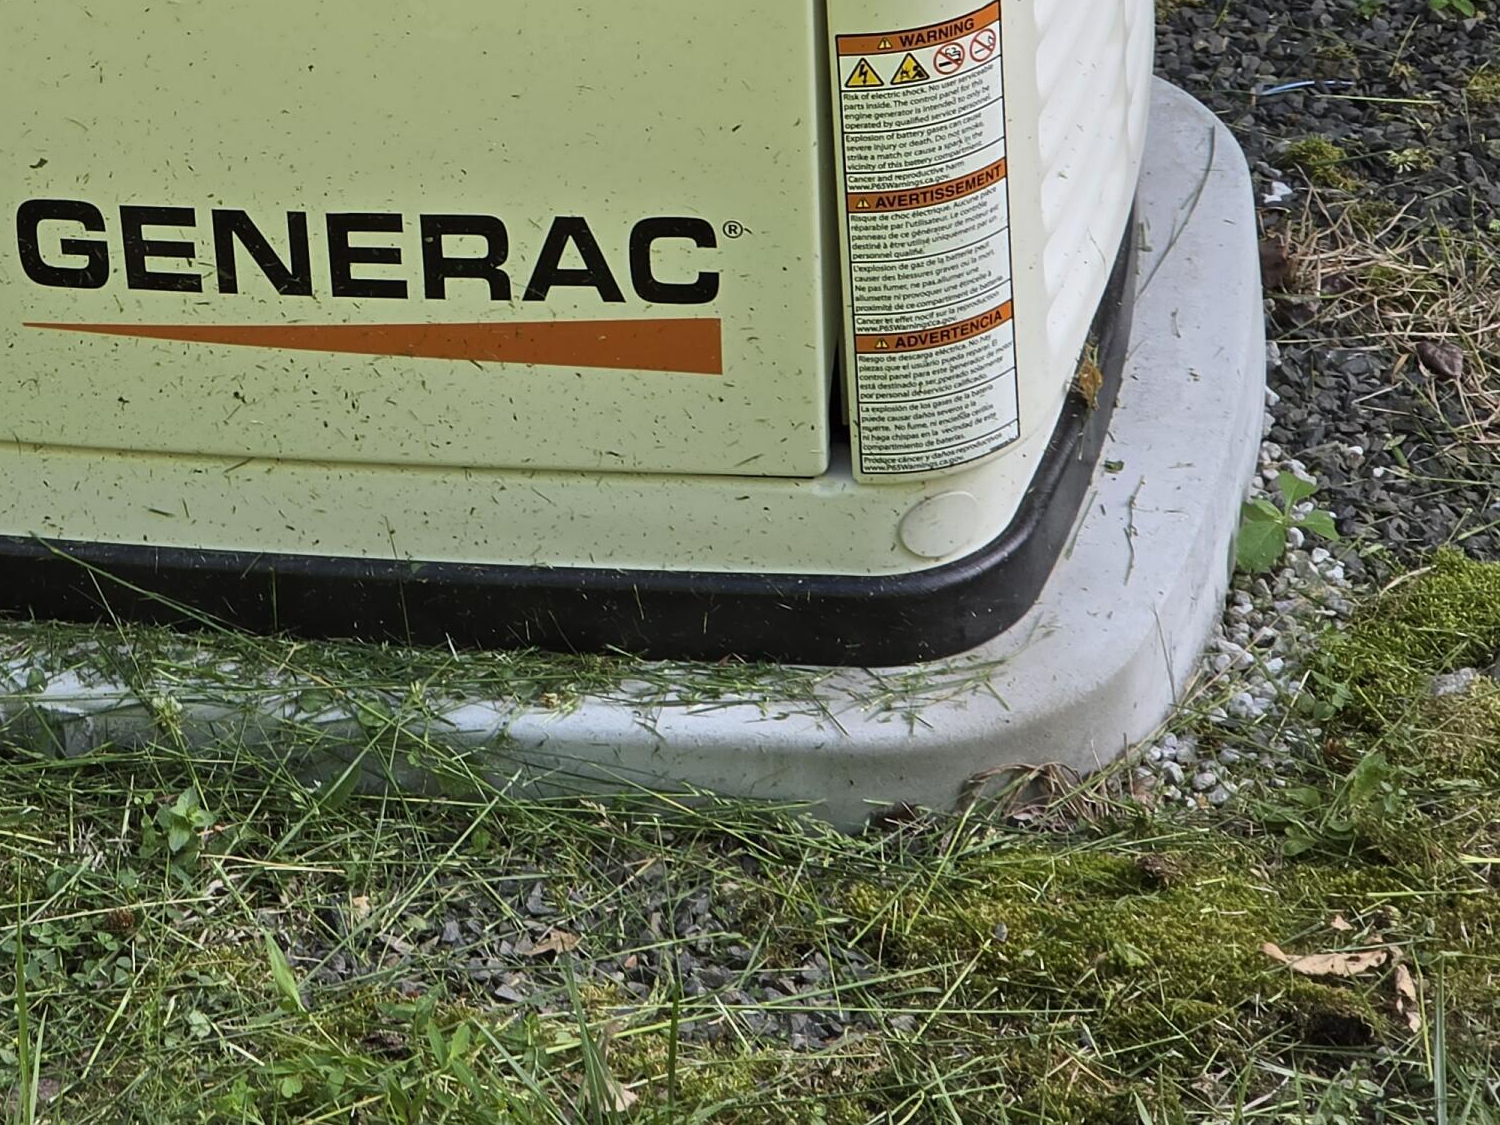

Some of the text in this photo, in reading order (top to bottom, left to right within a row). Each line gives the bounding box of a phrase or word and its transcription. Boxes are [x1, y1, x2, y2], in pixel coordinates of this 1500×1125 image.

[899, 18, 975, 48] WARNING
[871, 91, 901, 99] electric
[902, 87, 927, 96] shock.
[929, 84, 940, 92] No
[941, 80, 956, 89] user
[866, 101, 892, 109] inside.
[910, 94, 937, 105] control
[939, 87, 959, 100] panel
[844, 113, 872, 121] engine
[873, 109, 913, 120] generator
[923, 97, 956, 112] intended
[845, 121, 882, 130] operated
[883, 121, 893, 129] by
[895, 115, 929, 127] qualified
[931, 109, 957, 120] service
[845, 121, 962, 143] Explosion of battery gases can
[873, 143, 897, 152] injury
[908, 137, 934, 147] death.
[935, 134, 947, 142] Do
[948, 130, 960, 138] not
[877, 152, 902, 160] match
[914, 147, 936, 155] cause
[847, 162, 876, 171] vicinity
[904, 157, 933, 166] battery
[878, 174, 893, 182] and
[894, 167, 944, 181] reproductive
[875, 164, 1002, 209] AVERTISSEMENT
[850, 215, 877, 223] Risque
[851, 224, 889, 232] réparable
[852, 251, 892, 260] personnel
[910, 262, 925, 271] gaz
[881, 274, 896, 282] des
[897, 270, 934, 281] blessures
[855, 294, 892, 302] allumette
[902, 288, 943, 301] provoquer
[914, 311, 934, 320] nocif
[894, 310, 1003, 349] ADVERTENCIA
[859, 356, 885, 364] Riesgo
[898, 352, 934, 361] descarga
[859, 365, 884, 373] piezas
[859, 373, 888, 381] control
[889, 372, 911, 381] panel
[912, 371, 931, 380] para
[877, 381, 918, 390] destinado
[875, 390, 910, 400] personal
[871, 405, 908, 414] explosión
[909, 403, 919, 411] de
[932, 399, 953, 409] gases
[861, 415, 885, 423] puede
[871, 434, 890, 442] haga
[891, 433, 920, 441] chispas
[863, 442, 924, 451] compartimiento
